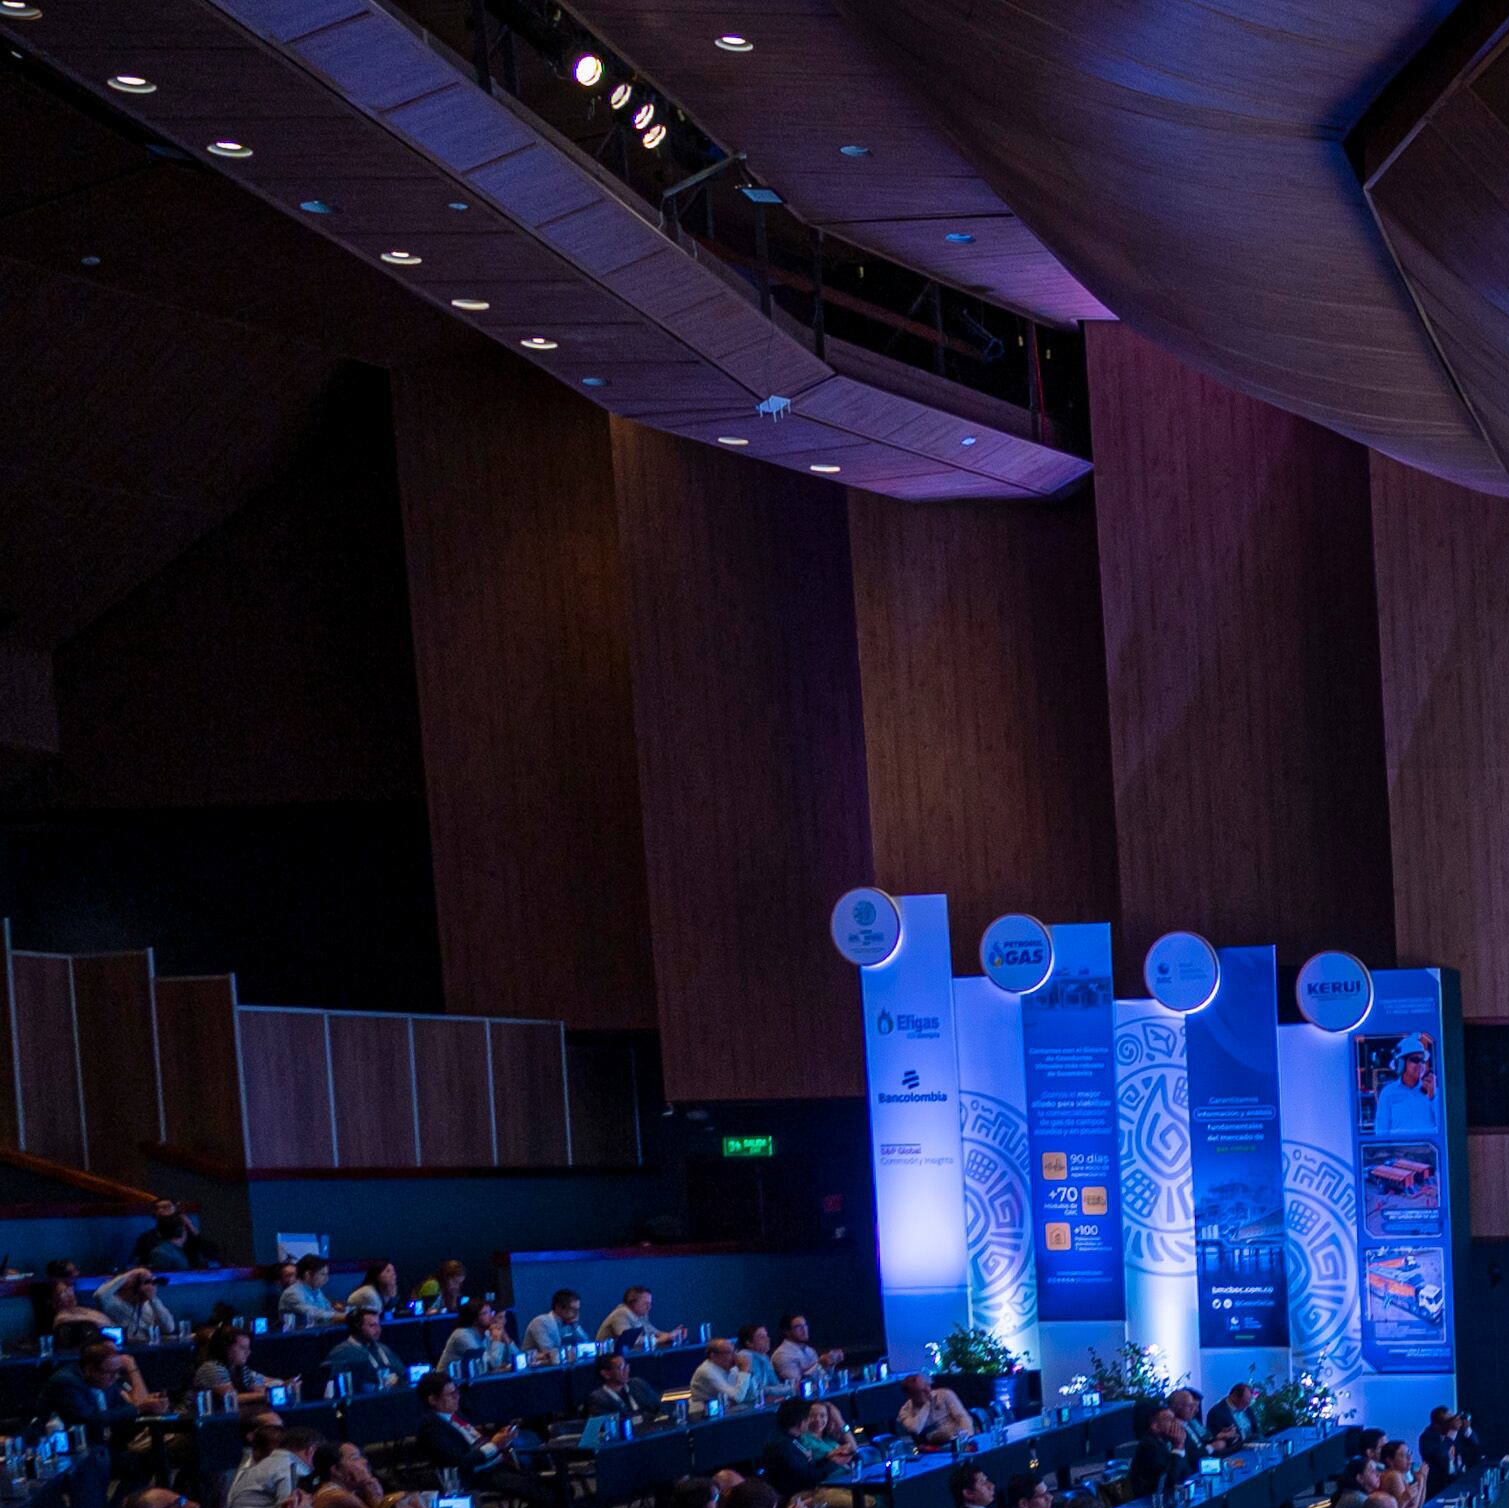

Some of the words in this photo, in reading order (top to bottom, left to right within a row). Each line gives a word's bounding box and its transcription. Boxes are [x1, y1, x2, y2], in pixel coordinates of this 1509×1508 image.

[1006, 950, 1043, 966] GAS
[1307, 980, 1361, 996] KERUI
[896, 1014, 939, 1032] Efigas
[878, 1092, 947, 1104] Bancolombia
[1049, 1187, 1078, 1202] +70
